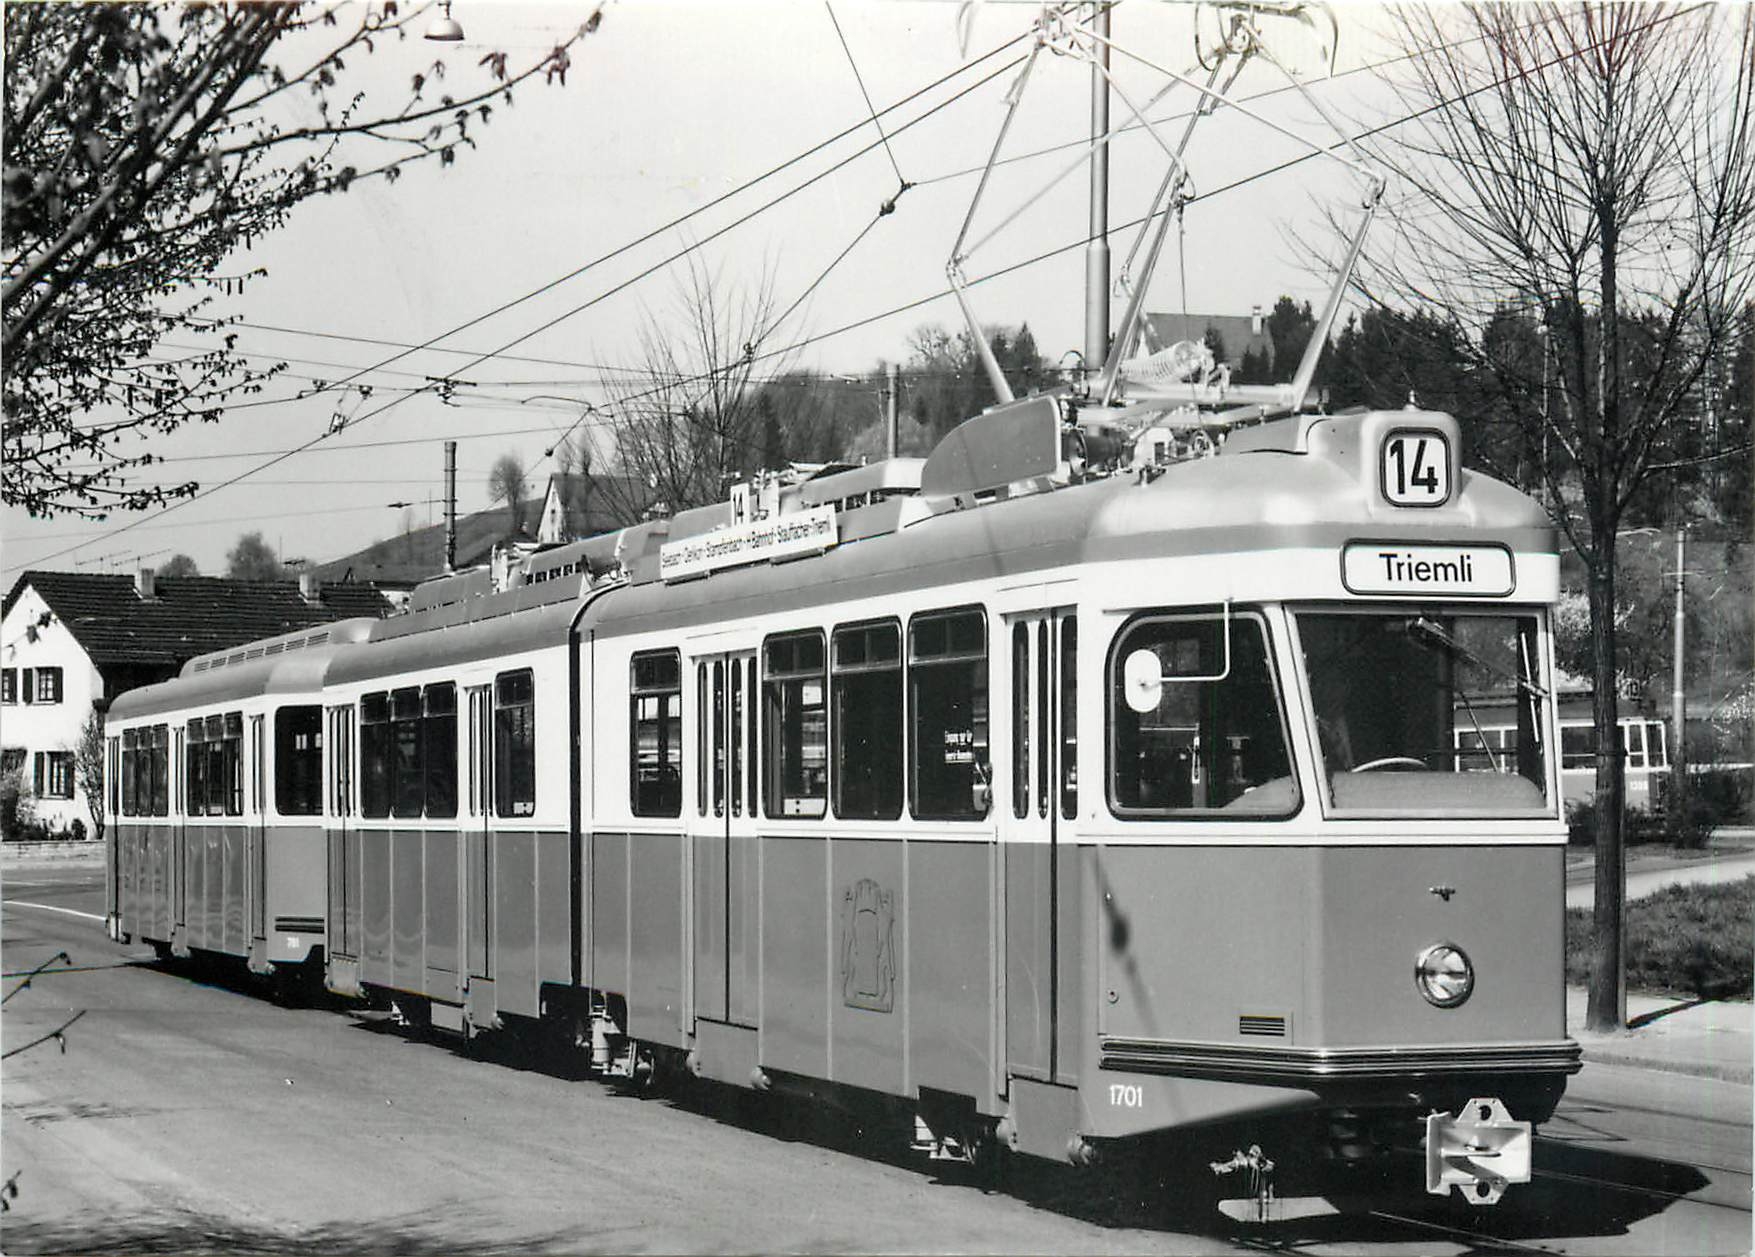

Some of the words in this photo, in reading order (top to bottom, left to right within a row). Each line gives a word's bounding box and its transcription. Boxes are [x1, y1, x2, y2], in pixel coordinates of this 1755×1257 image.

[1390, 439, 1438, 495] 14
[732, 492, 744, 526] 14
[1379, 553, 1473, 582] Triemli
[1110, 1084, 1143, 1107] 1701
